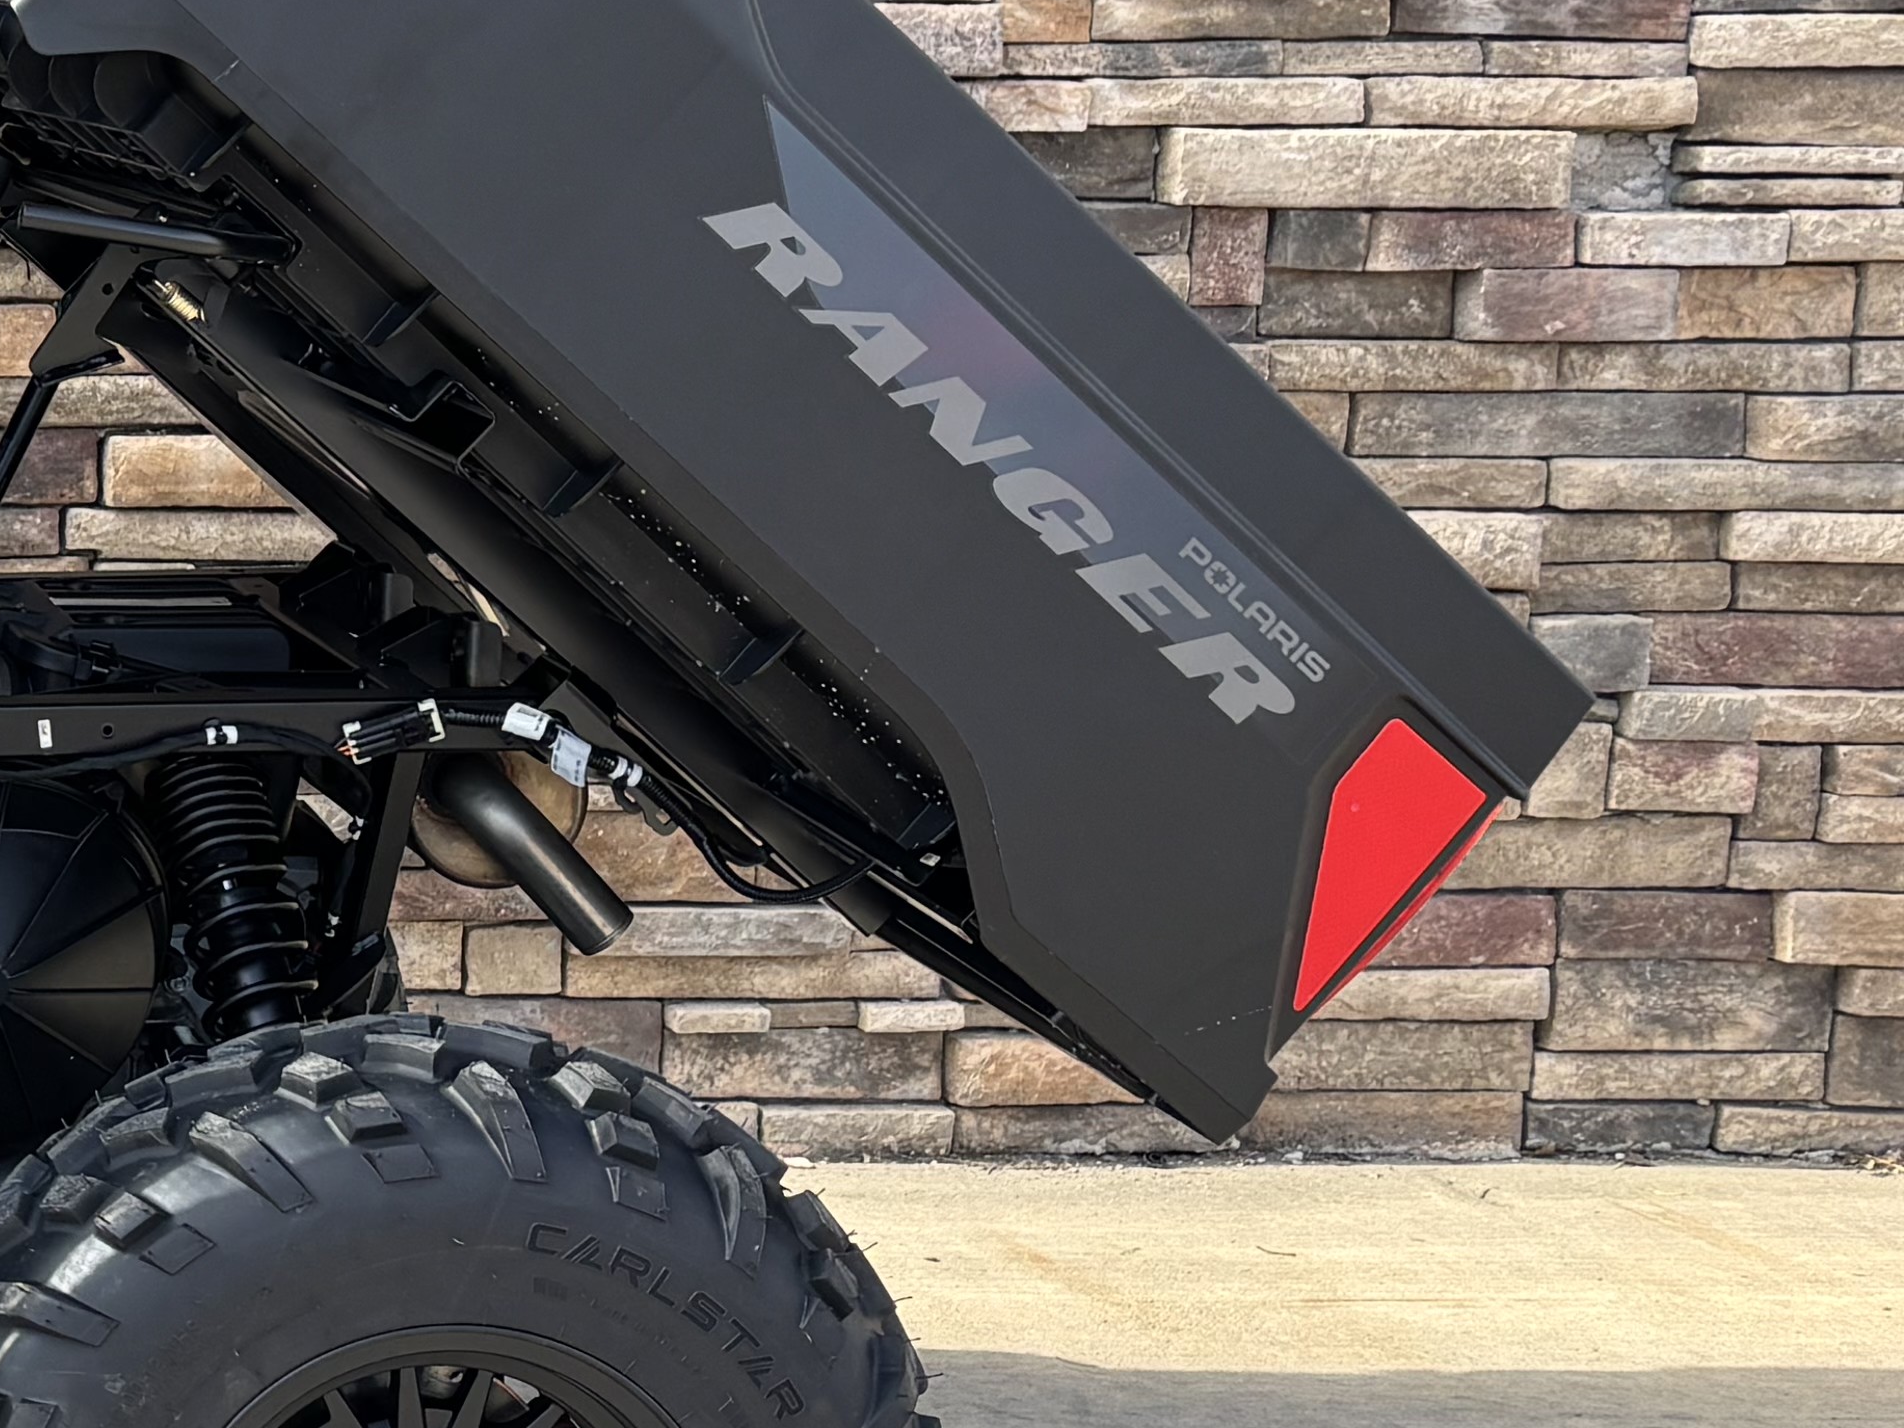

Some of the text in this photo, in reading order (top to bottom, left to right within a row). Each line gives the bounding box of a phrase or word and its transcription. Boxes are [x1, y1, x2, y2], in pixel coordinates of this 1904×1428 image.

[700, 202, 1297, 727] RANGER
[1178, 537, 1331, 684] POLARIS
[526, 1222, 806, 1420] CARLSTAR
